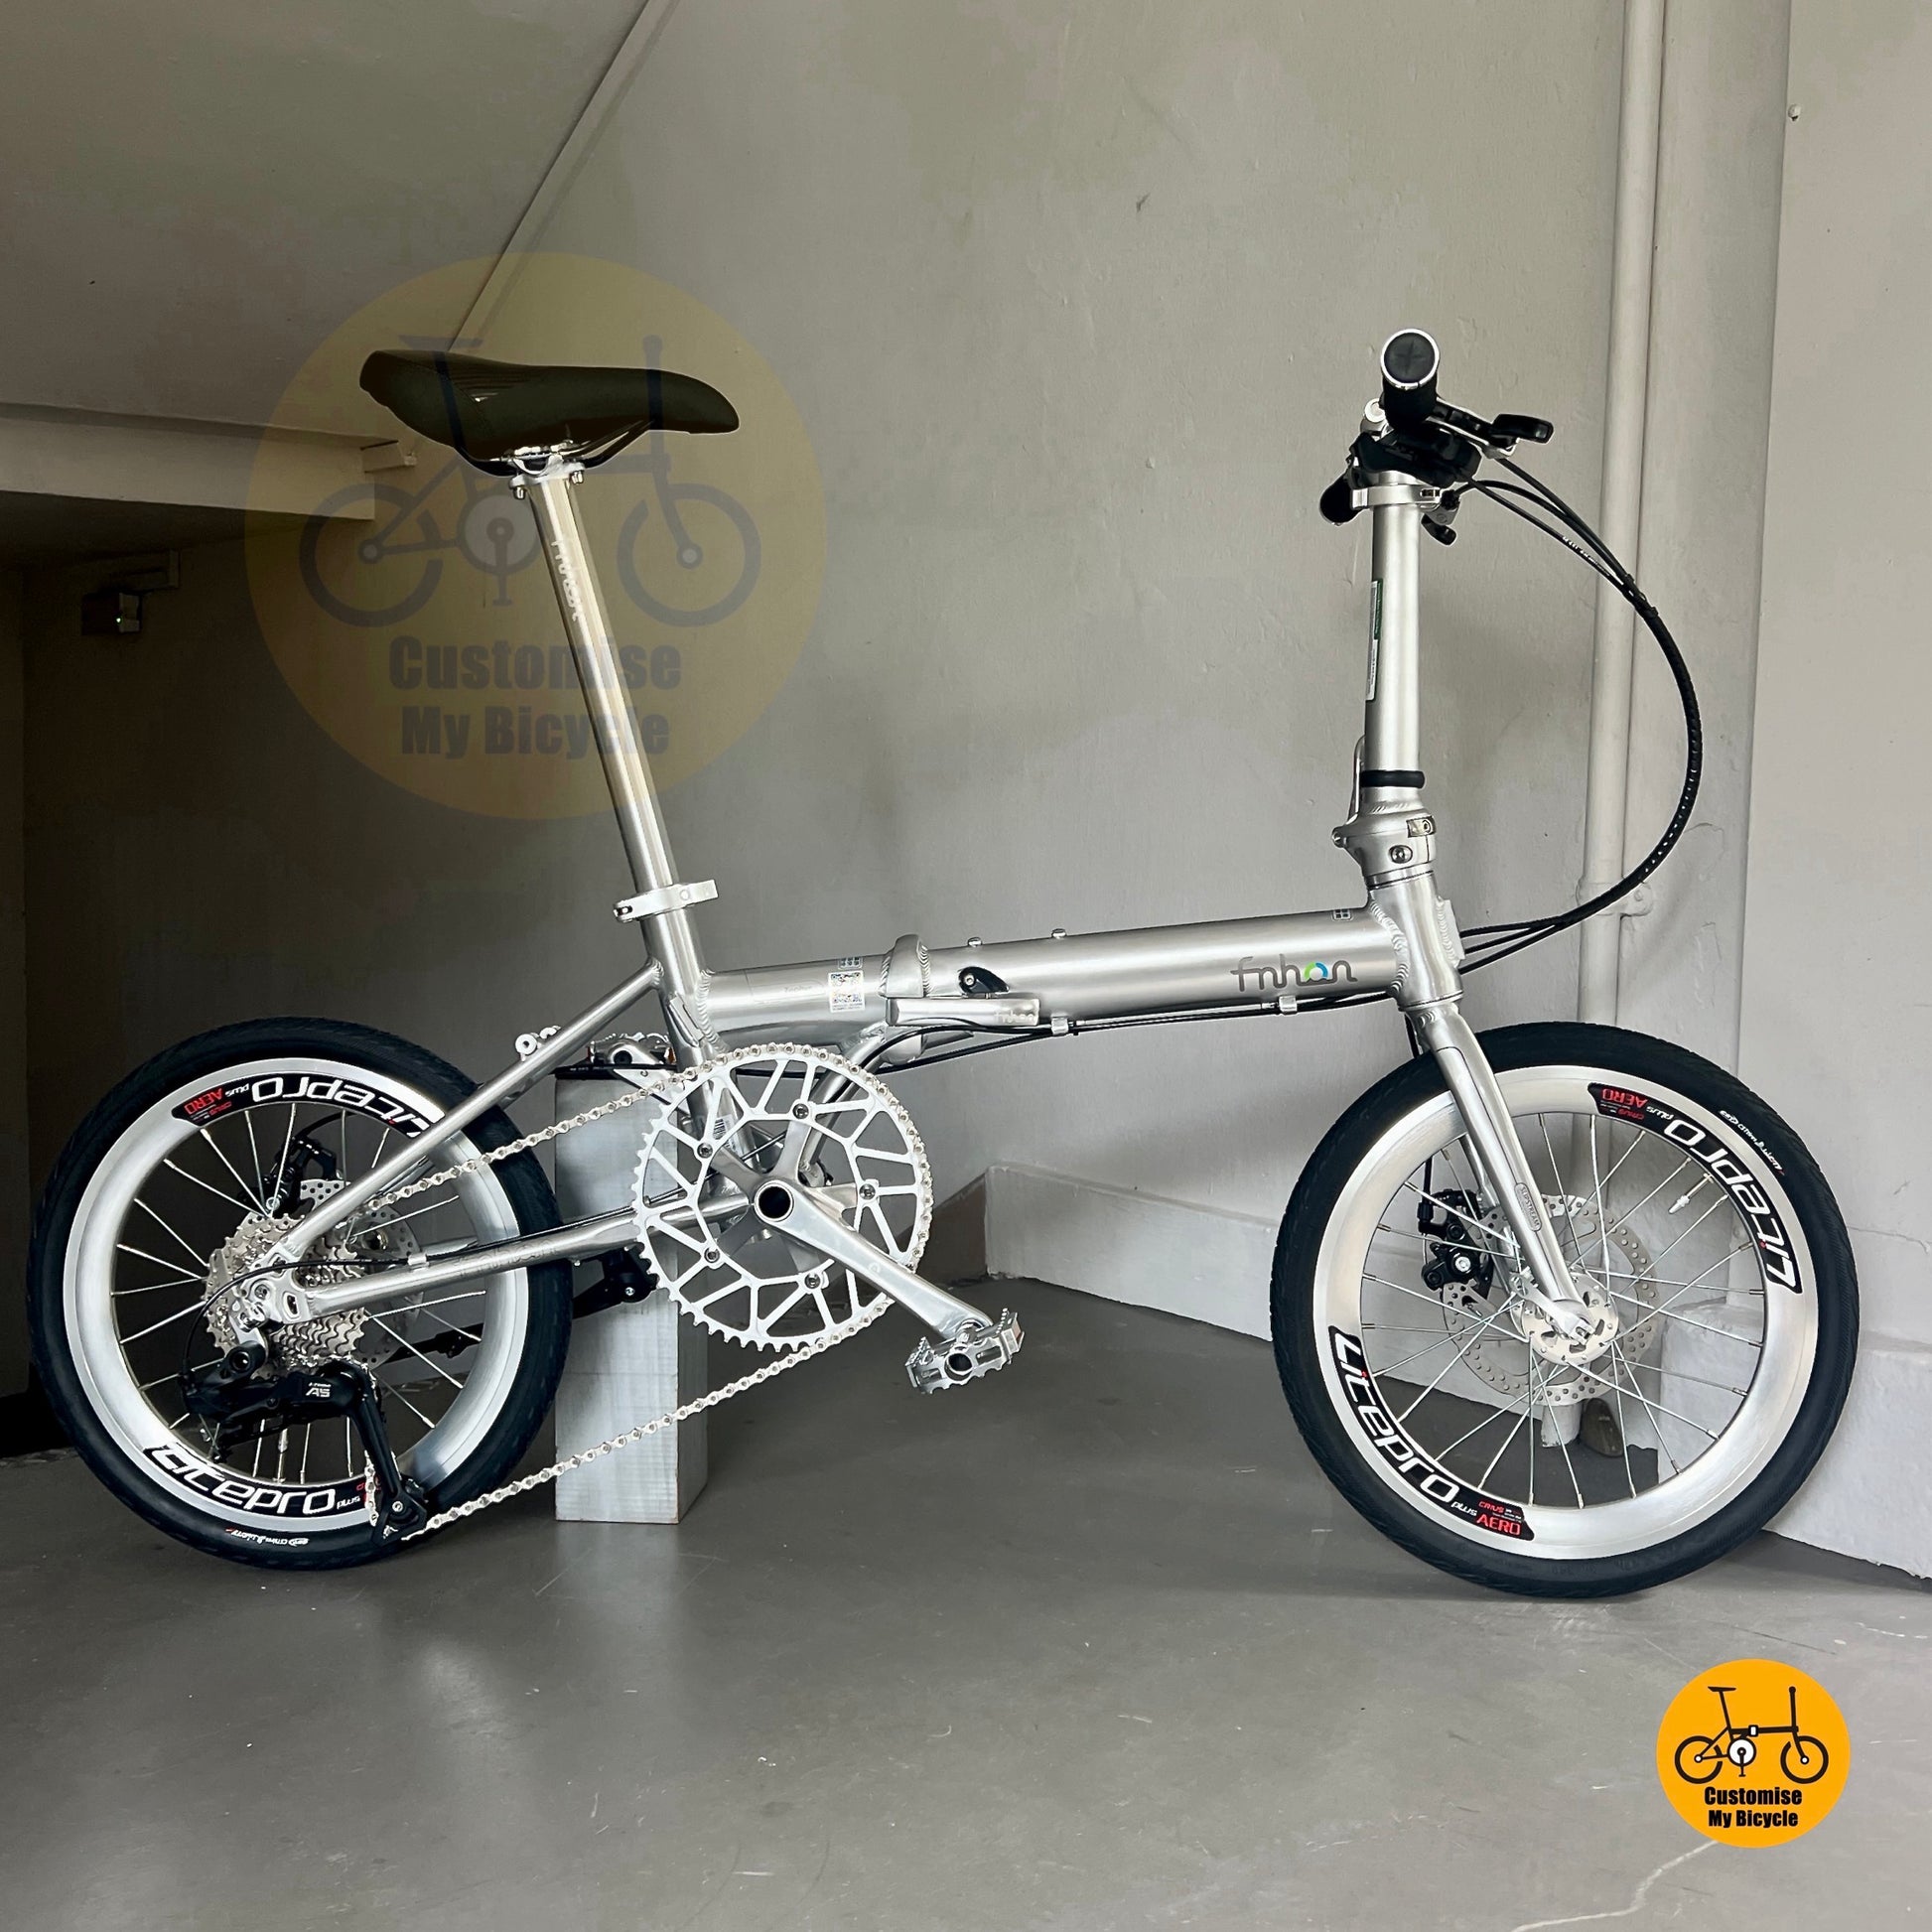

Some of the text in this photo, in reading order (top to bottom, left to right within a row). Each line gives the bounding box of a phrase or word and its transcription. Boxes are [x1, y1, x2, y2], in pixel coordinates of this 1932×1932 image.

[1230, 954, 1358, 992] fnhon
[184, 1088, 224, 1115] AERO
[1601, 1087, 1648, 1107] AERO
[1663, 1118, 1795, 1287] Litepro
[1334, 1332, 1478, 1517] Litepro plus
[1475, 1514, 1521, 1536] AERO
